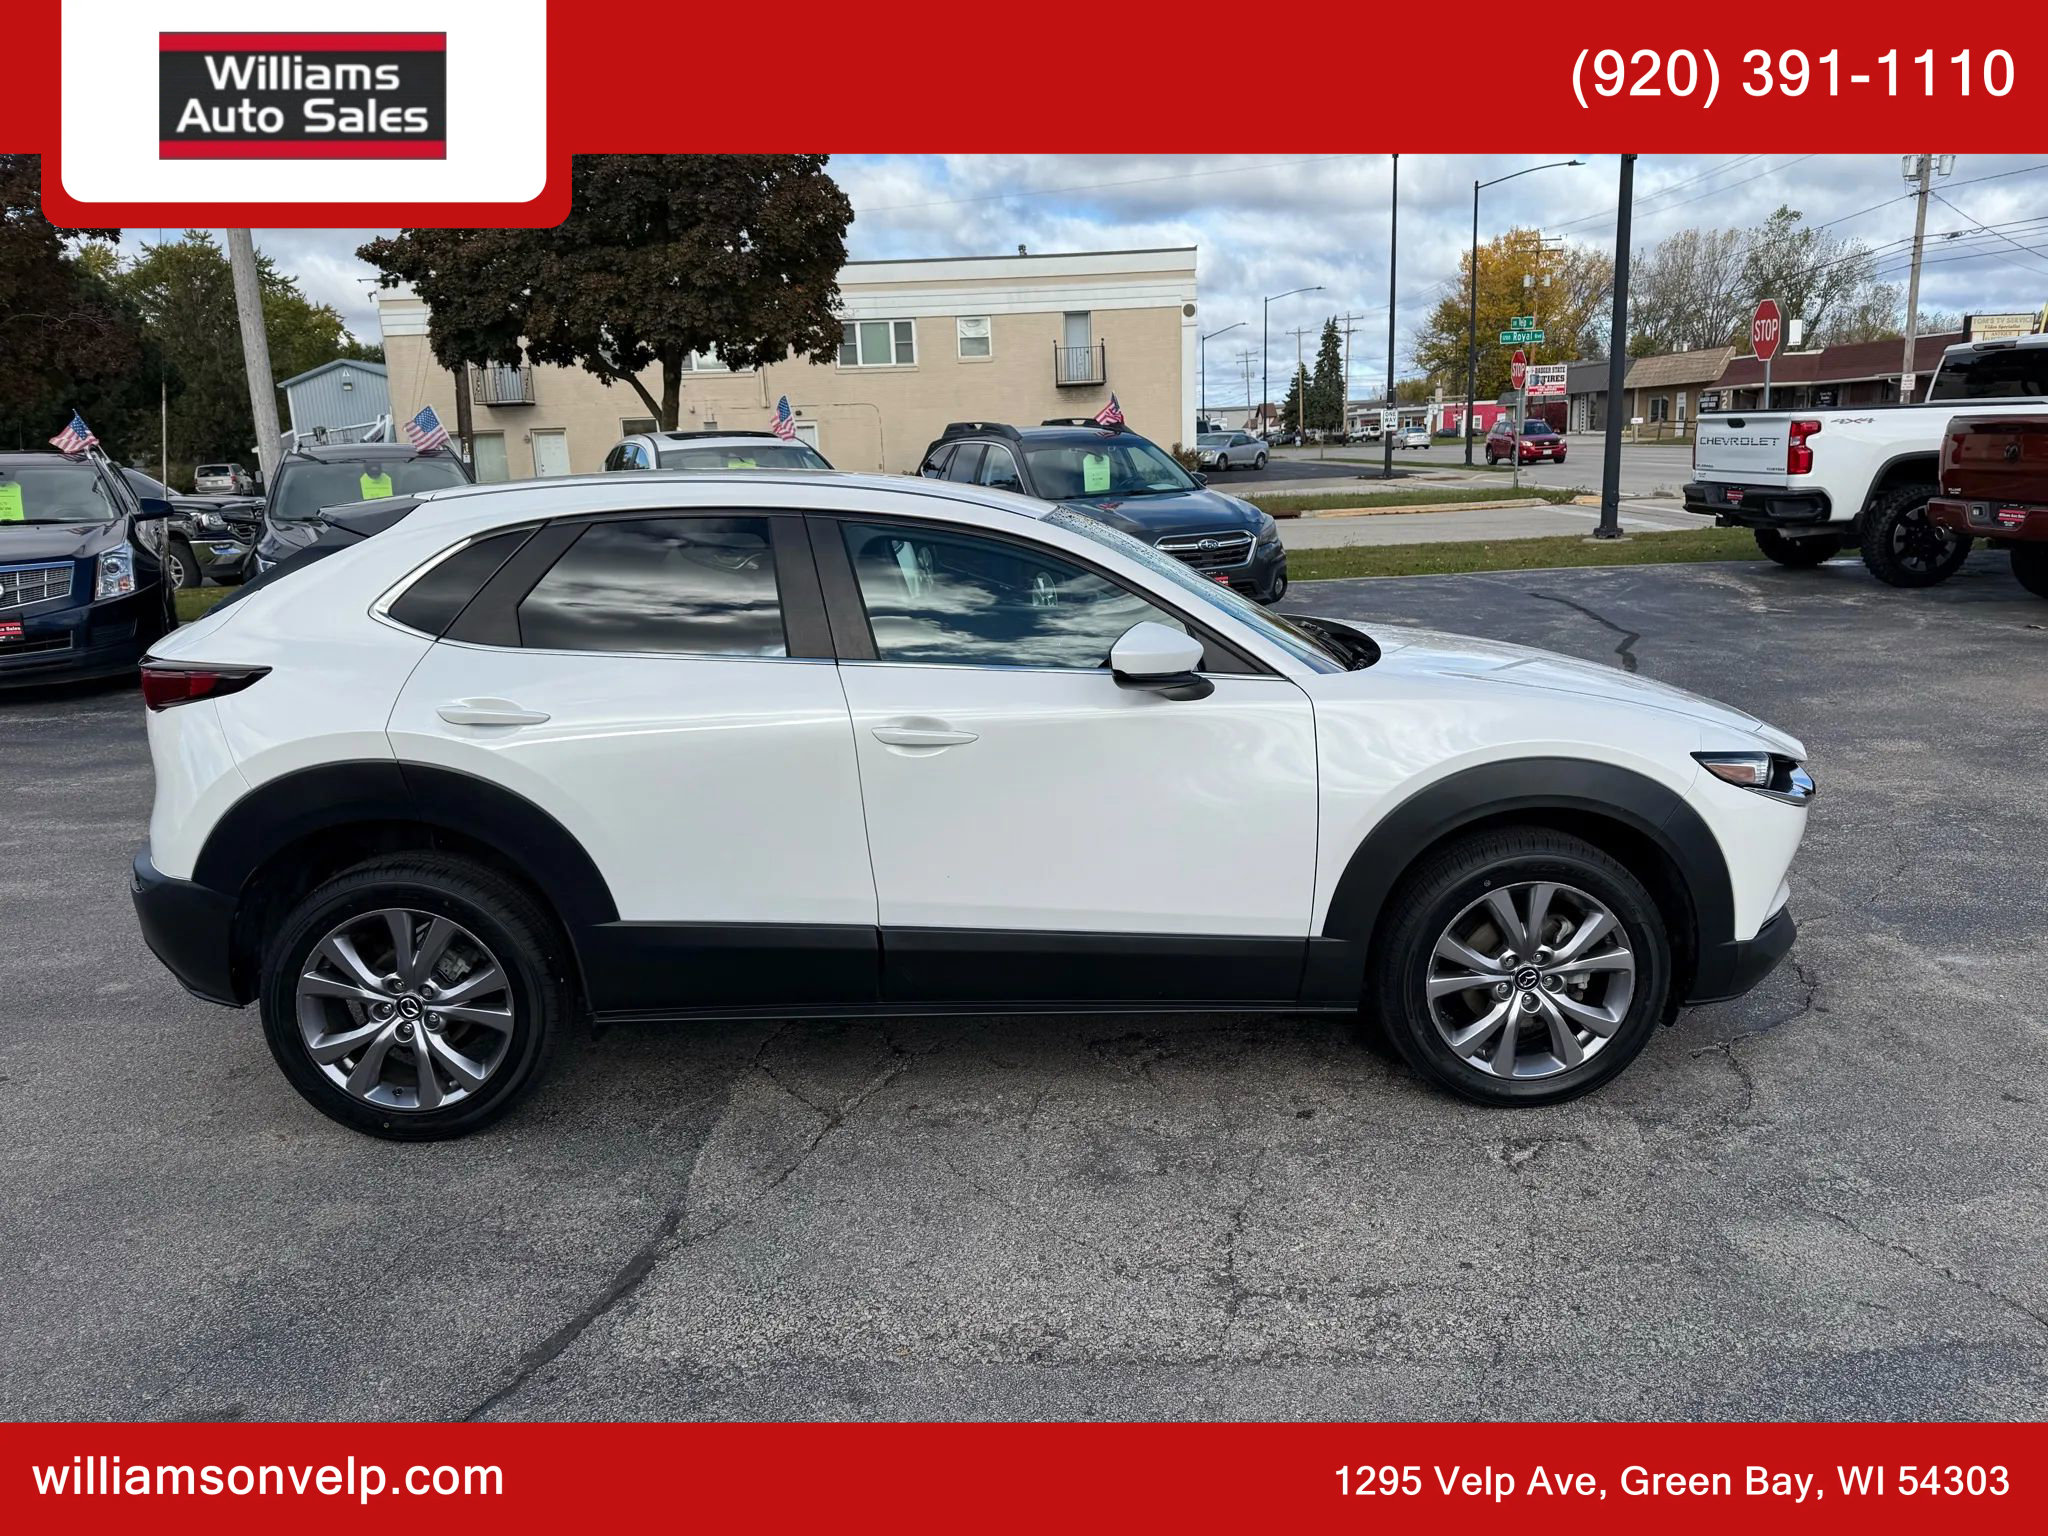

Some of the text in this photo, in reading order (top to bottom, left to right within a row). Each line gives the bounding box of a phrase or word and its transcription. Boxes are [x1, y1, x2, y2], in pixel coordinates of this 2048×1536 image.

[1754, 319, 1778, 342] STOP
[1512, 331, 1533, 342] Royal
[1512, 363, 1525, 377] STOP
[1543, 374, 1565, 383] TIRES
[1699, 436, 1781, 447] CHEVROLET
